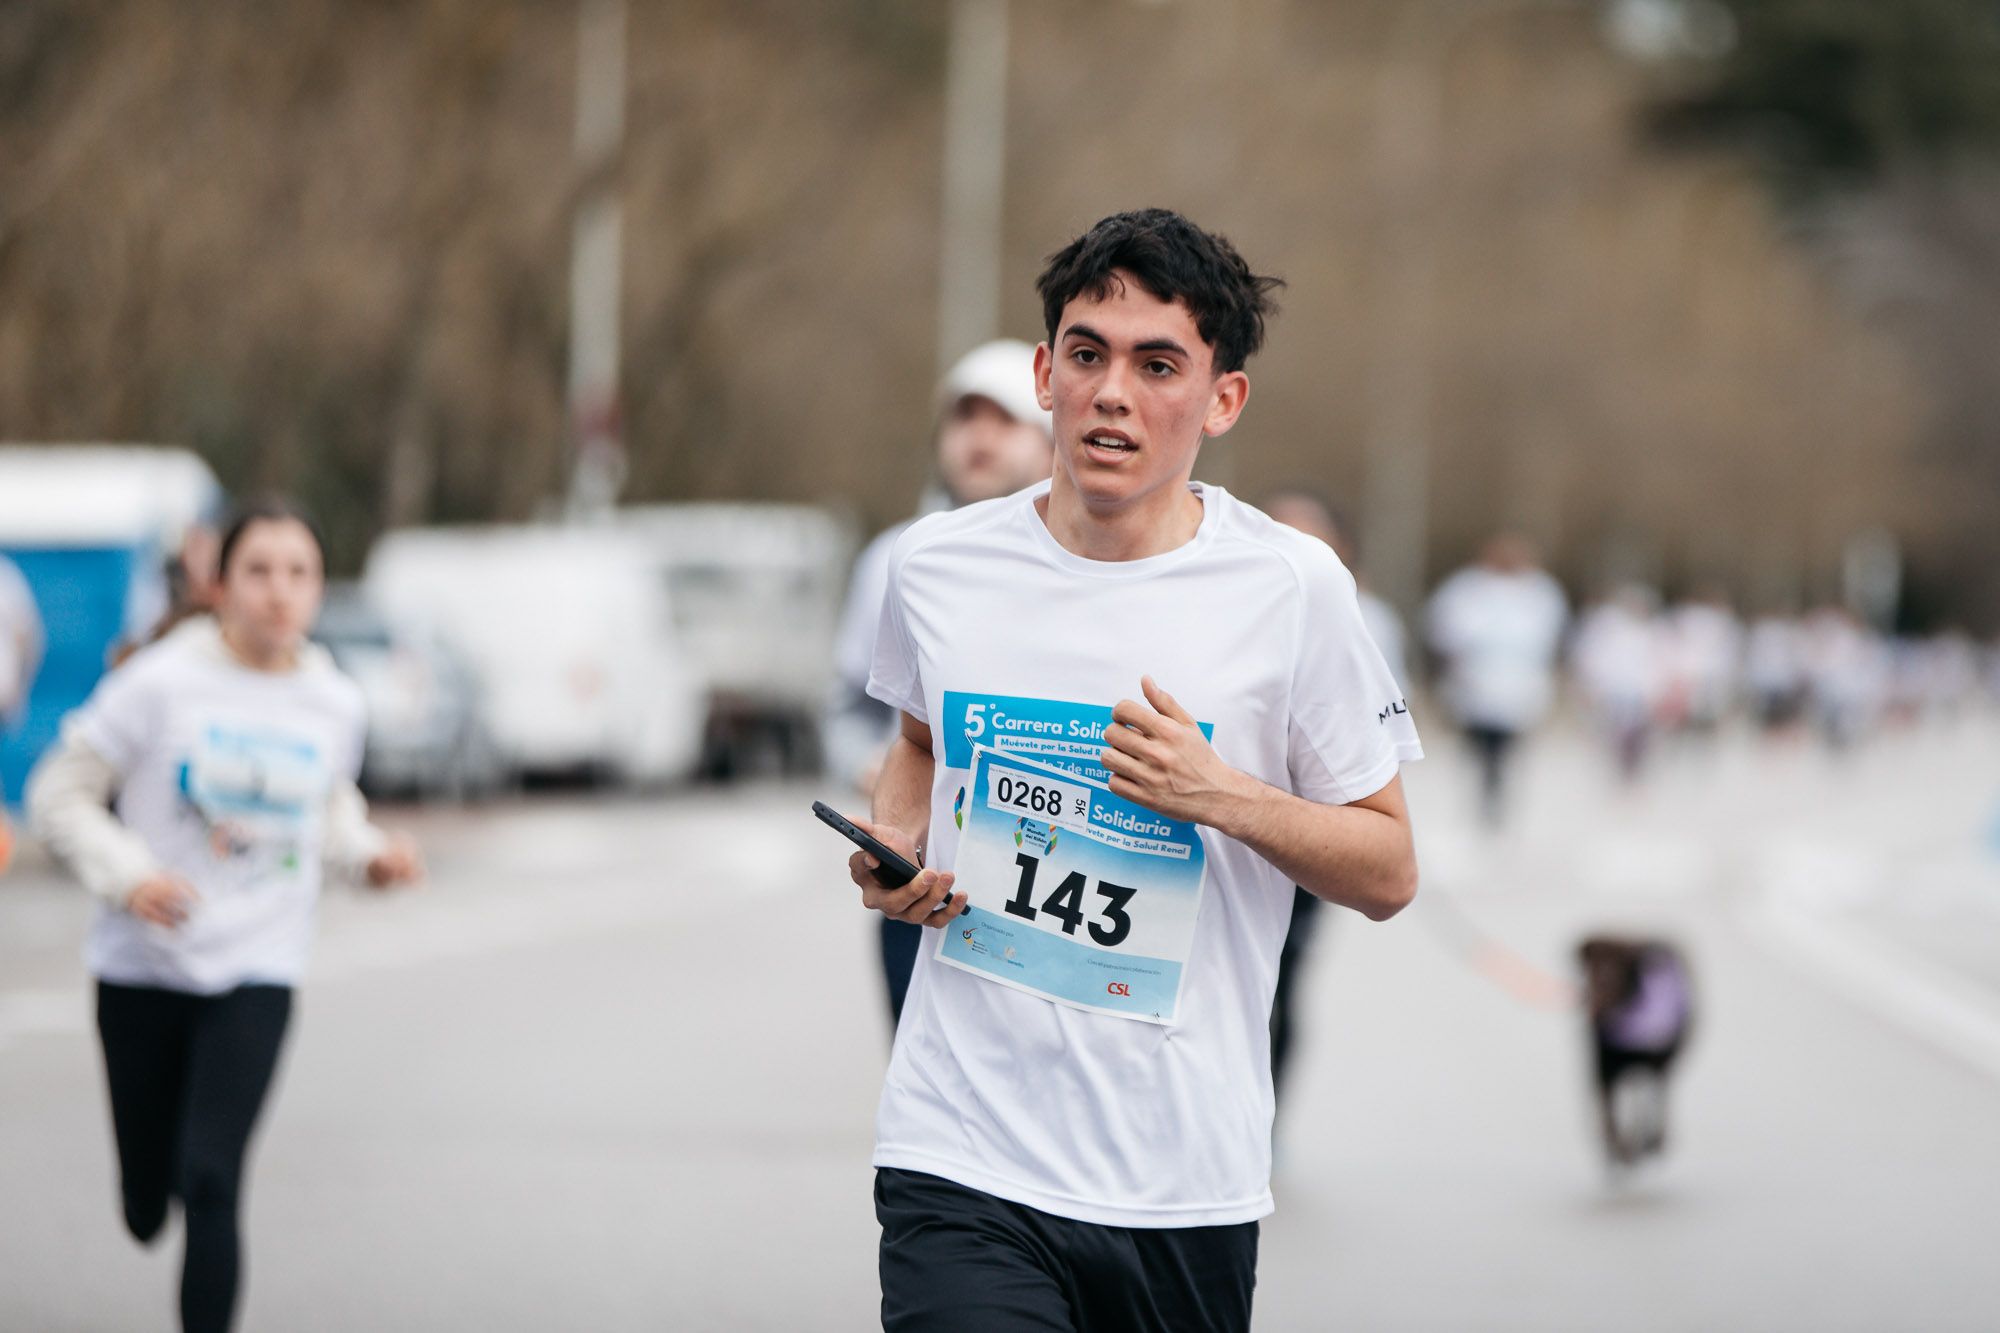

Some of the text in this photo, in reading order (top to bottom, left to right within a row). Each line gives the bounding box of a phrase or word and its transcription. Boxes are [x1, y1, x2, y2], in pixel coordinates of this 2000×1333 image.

[991, 712, 1063, 735] Carrera
[1000, 738, 1039, 749] Muévete
[1041, 743, 1056, 752] por
[1057, 744, 1067, 752] la
[1069, 745, 1094, 756] Salud
[1067, 763, 1083, 774] de
[1085, 767, 1114, 779] marz
[997, 777, 1063, 817] 0268
[1074, 798, 1087, 817] 5K
[1092, 804, 1171, 837] Solidaria
[1087, 828, 1187, 855] vete por la Salud Renal
[1005, 852, 1138, 947] 143
[1107, 982, 1131, 997] CSL
